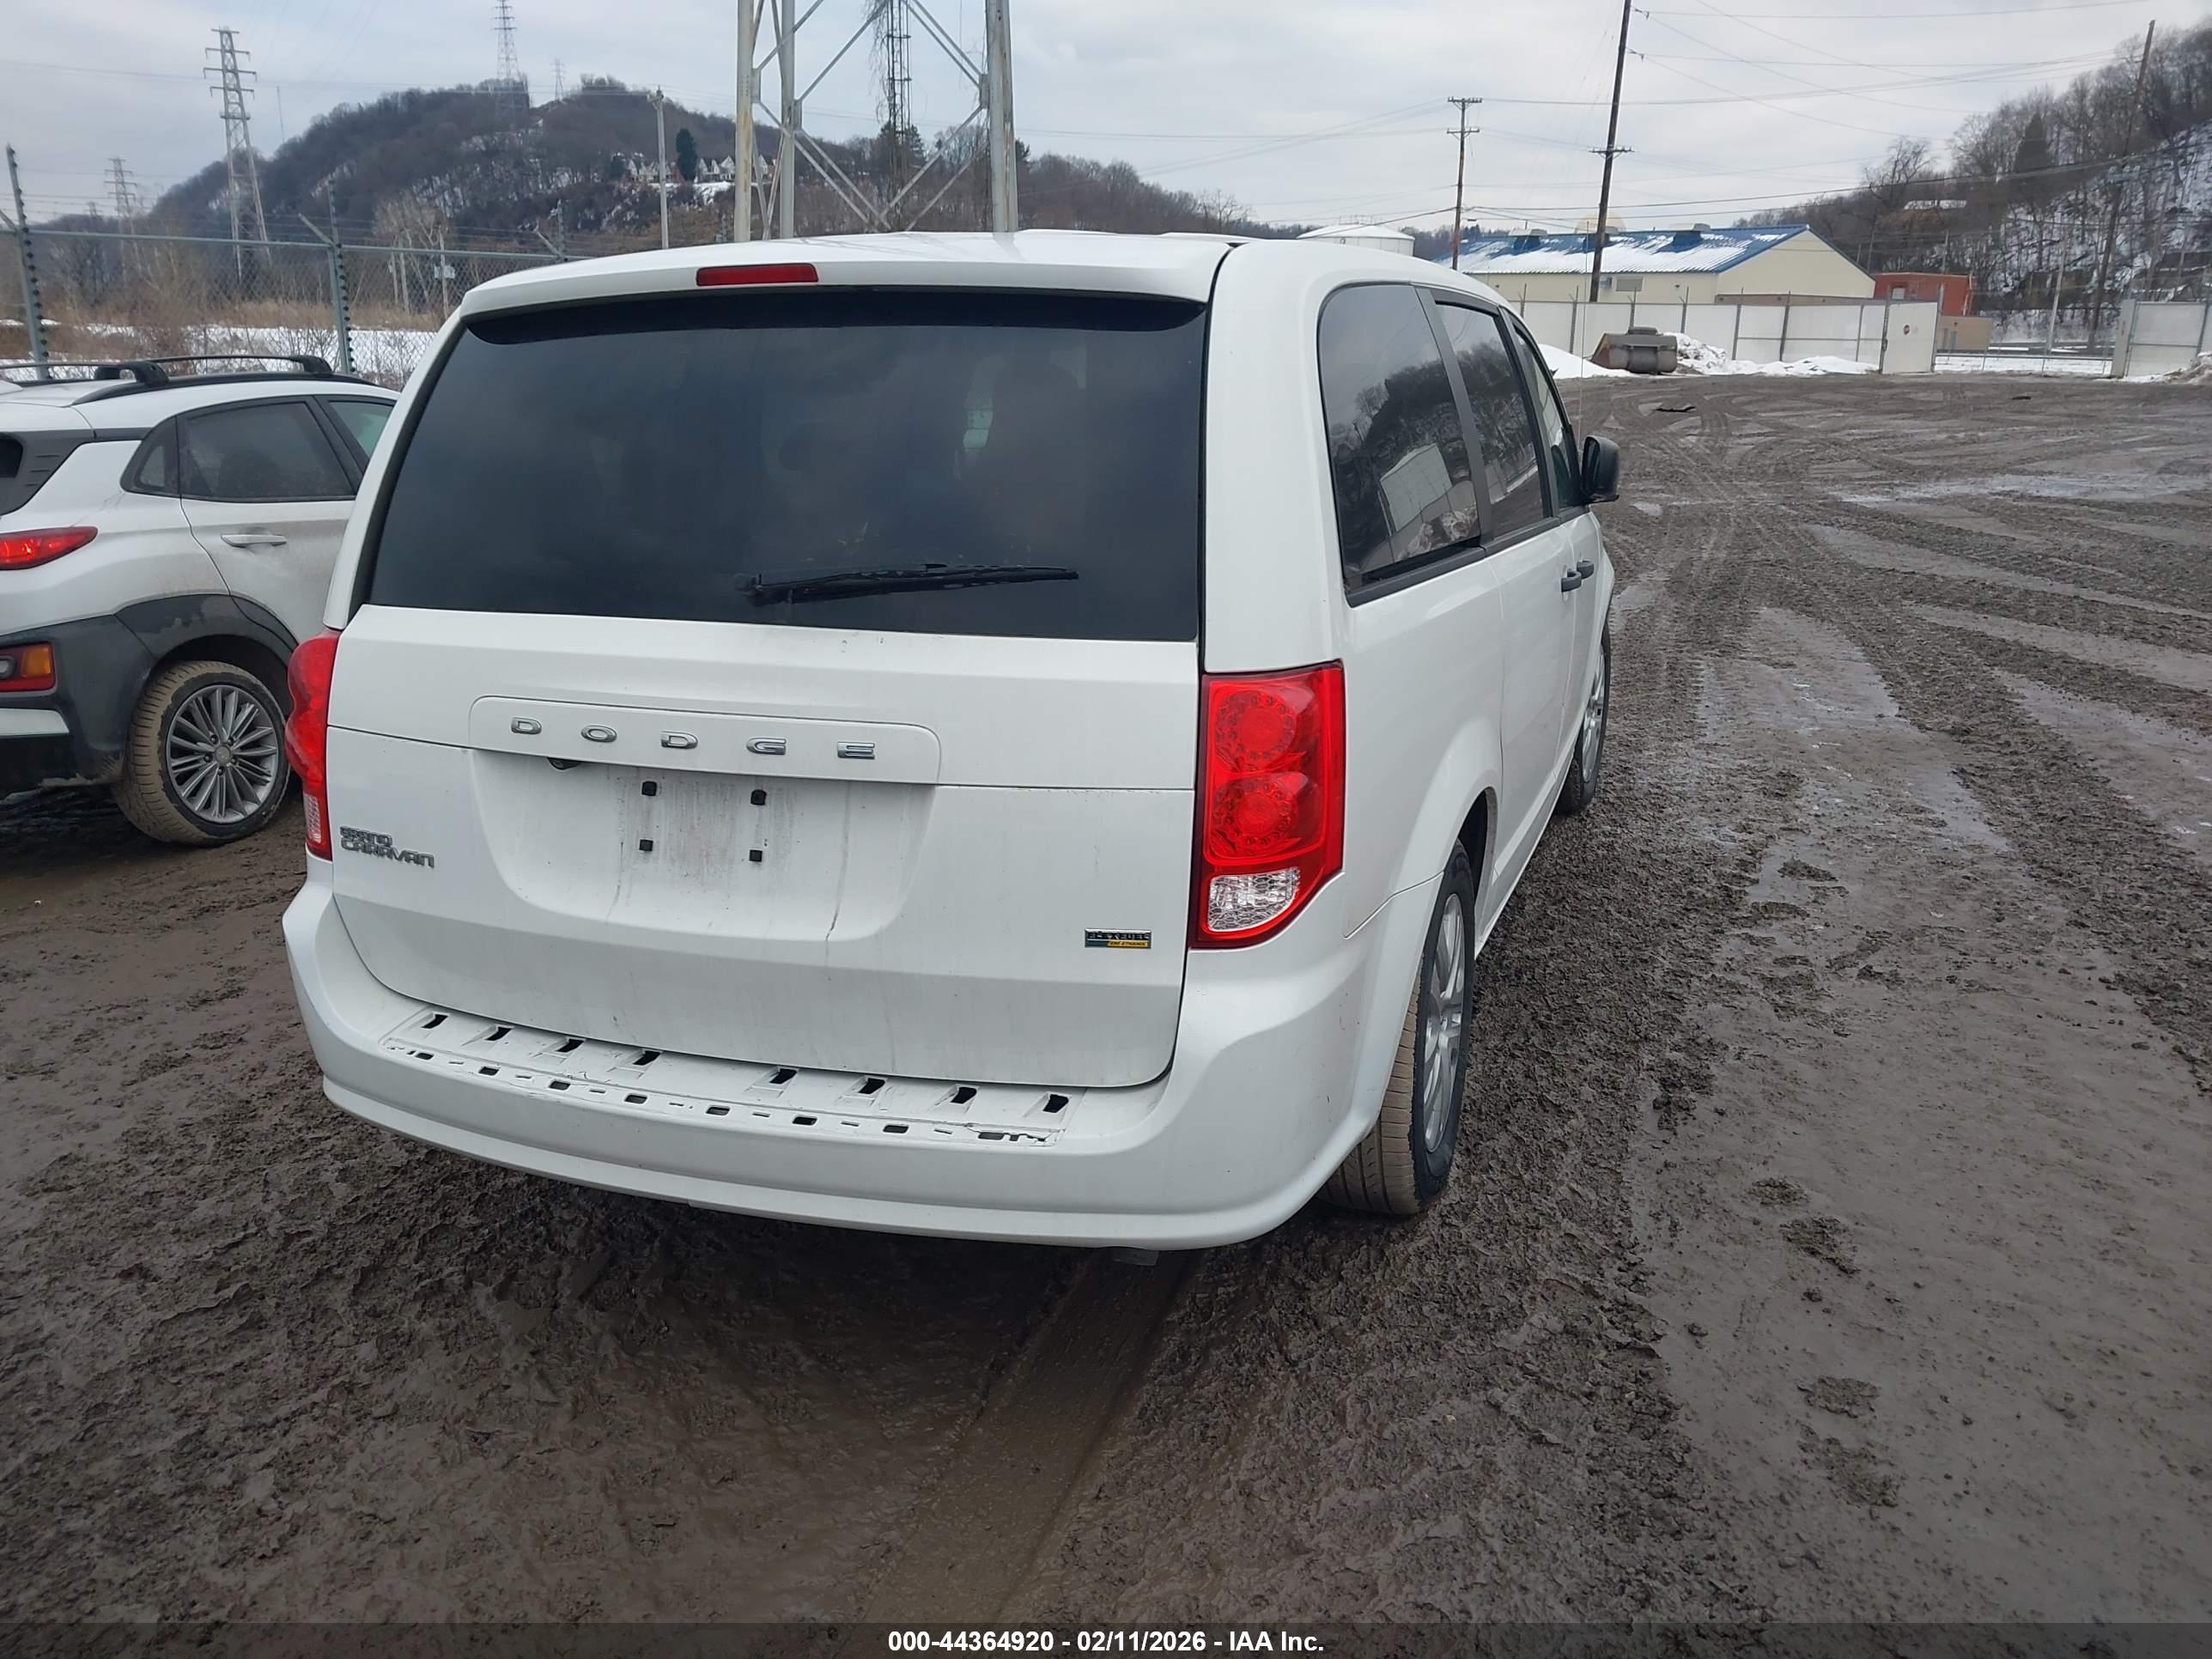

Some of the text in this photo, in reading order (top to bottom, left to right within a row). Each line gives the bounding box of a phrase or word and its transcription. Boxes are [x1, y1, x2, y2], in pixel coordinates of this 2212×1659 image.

[510, 717, 876, 760] DODGE
[339, 826, 392, 847] GRAND
[340, 837, 434, 868] CARAVAN
